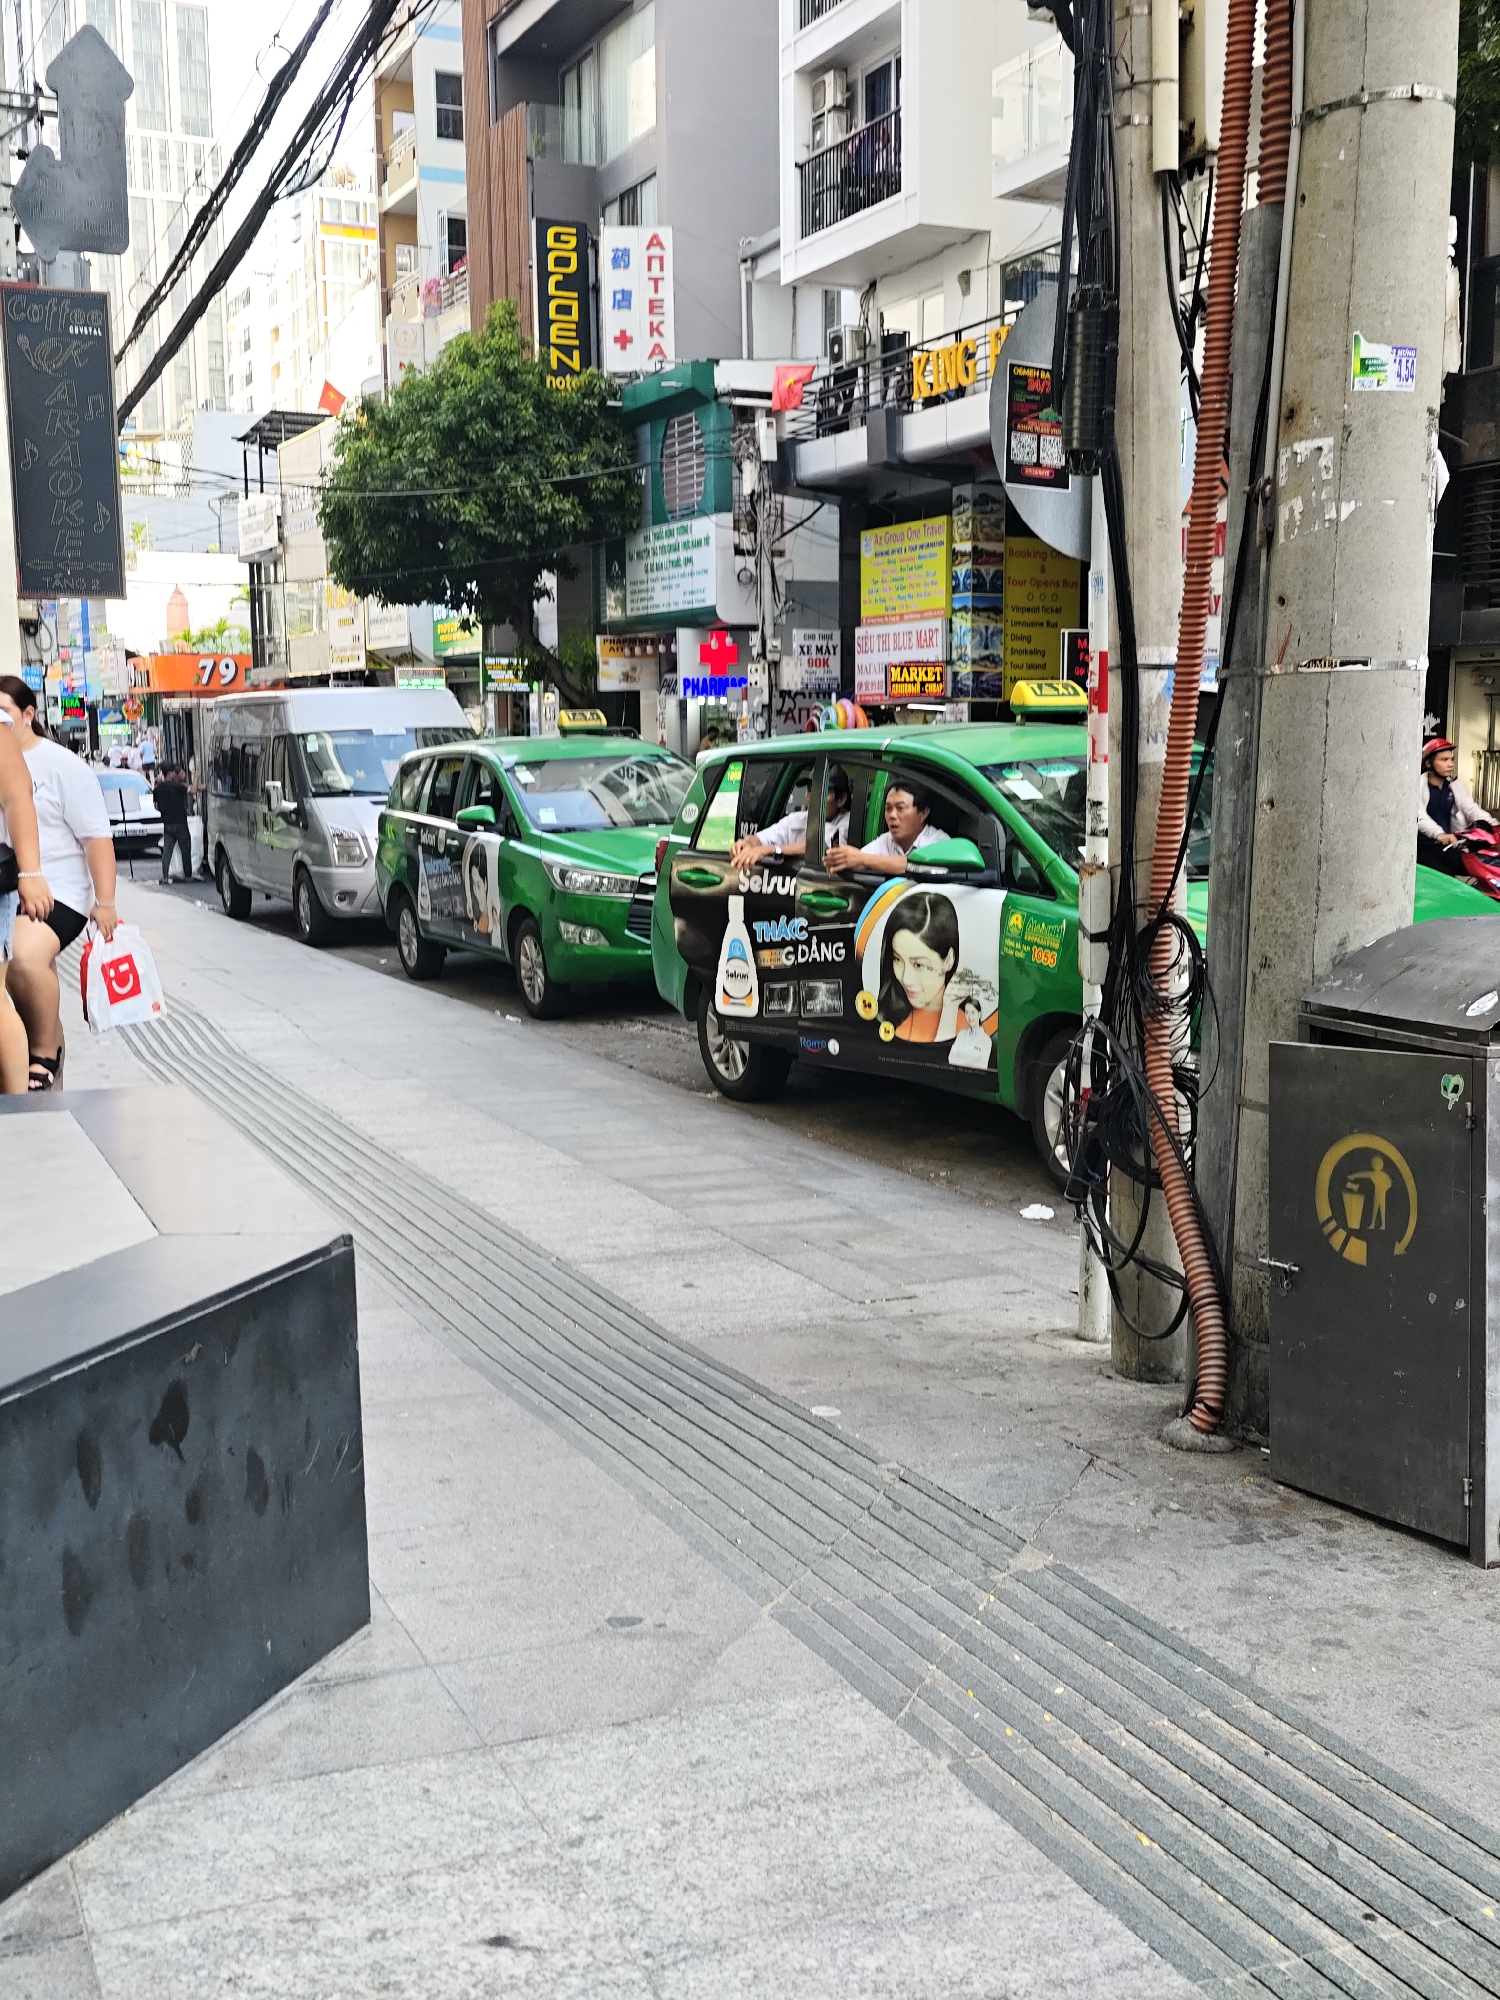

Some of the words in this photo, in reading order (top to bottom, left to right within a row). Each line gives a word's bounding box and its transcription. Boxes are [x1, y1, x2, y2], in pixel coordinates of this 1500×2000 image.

[547, 225, 581, 372] GOLDEN
[645, 232, 668, 360] АПТЕКА
[7, 293, 103, 332] Coffee
[911, 338, 977, 401] KING
[34, 336, 98, 557] KARAOKE
[884, 530, 905, 545] Group
[907, 526, 921, 540] One
[922, 521, 944, 537] Travel
[1008, 547, 1048, 561] Booking
[1007, 577, 1026, 588] Tour
[1029, 576, 1060, 589] Opens
[1062, 578, 1079, 589] Bus
[1011, 619, 1045, 628] Limousine
[1046, 619, 1059, 628] Bus
[798, 643, 812, 656] XE
[815, 640, 838, 656] MÁY
[856, 629, 875, 655] SIÊU
[893, 630, 914, 651] BLUE
[915, 627, 939, 649] MART
[1010, 633, 1032, 644] Diving
[1010, 647, 1046, 658] Snorkeling
[198, 657, 238, 686] 79
[890, 666, 943, 682] MARKET
[1010, 661, 1024, 670] Tour
[1026, 662, 1047, 670] Island
[924, 682, 943, 694] CHEAP
[1031, 945, 1058, 968] 1055
